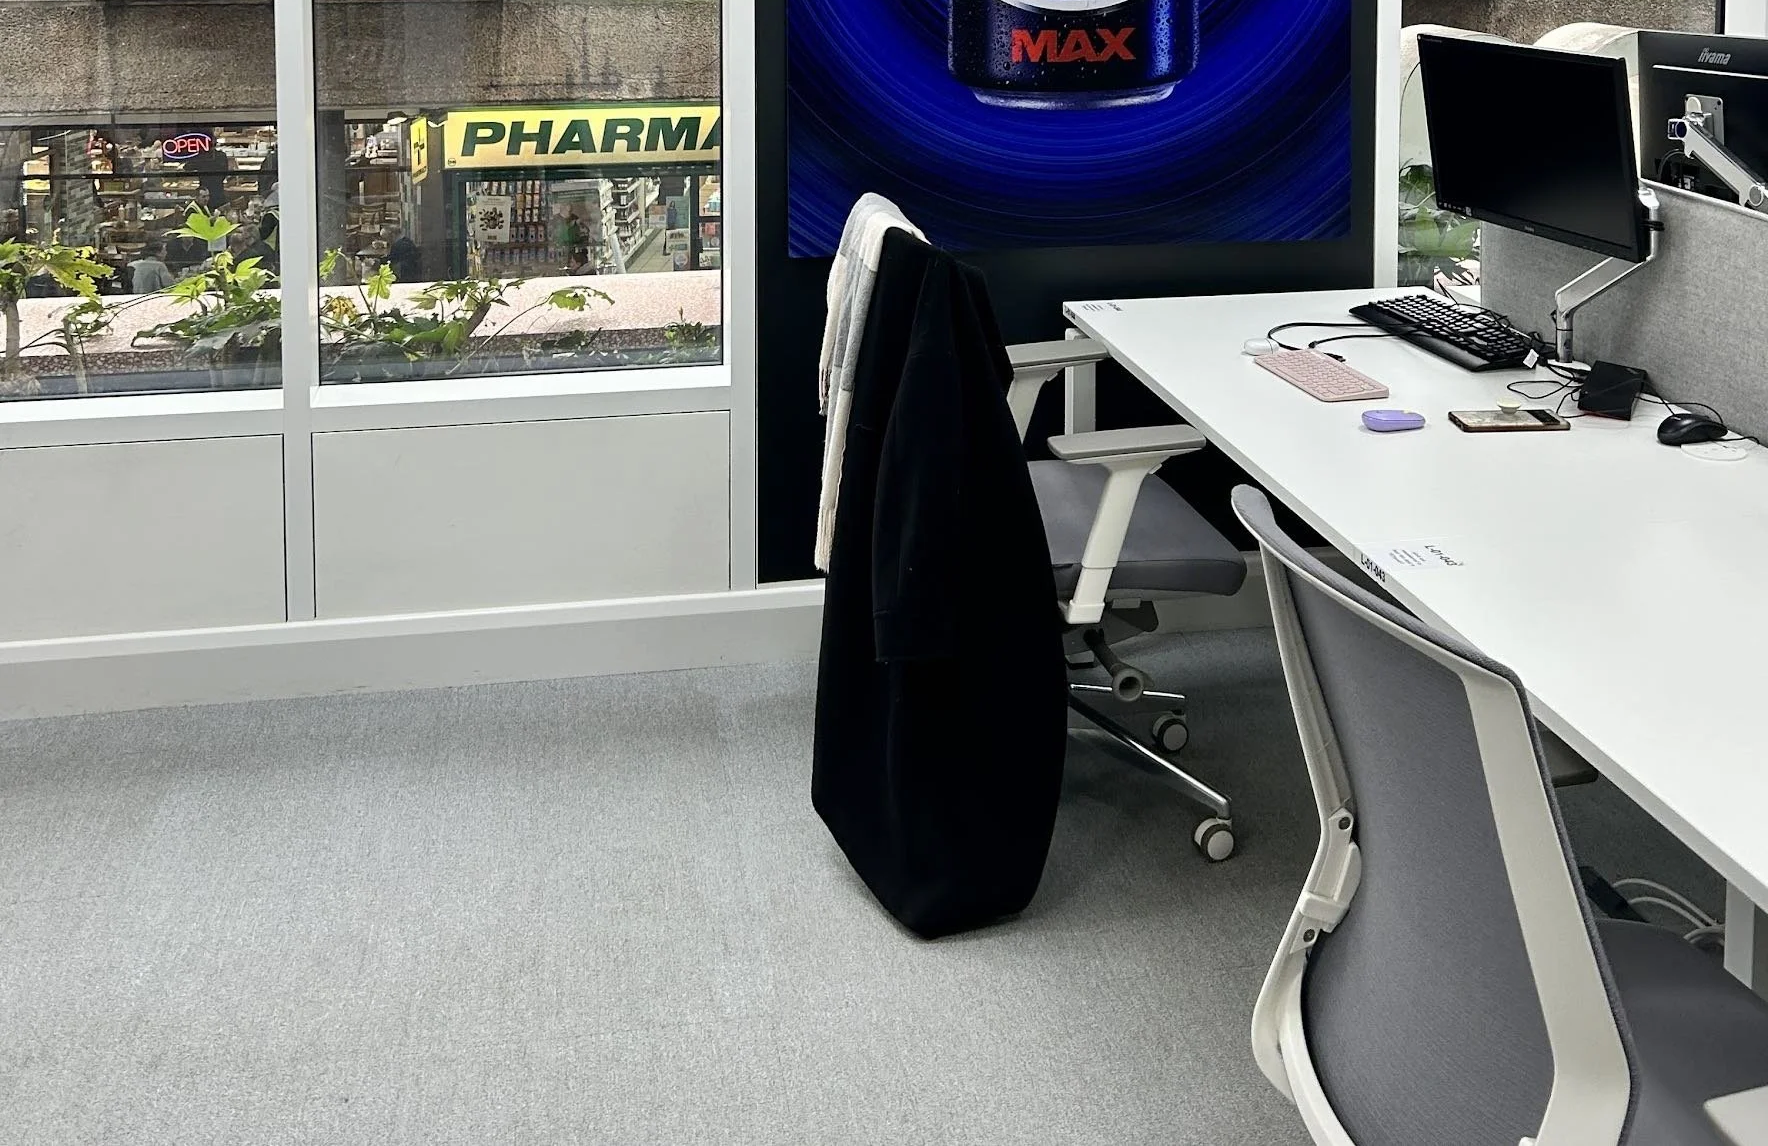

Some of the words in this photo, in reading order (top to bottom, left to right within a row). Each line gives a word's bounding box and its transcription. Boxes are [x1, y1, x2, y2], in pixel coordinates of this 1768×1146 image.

[1010, 27, 1137, 63] MAX
[1697, 46, 1731, 65] iiyama
[162, 137, 210, 154] OPEN
[1360, 553, 1386, 583] L-01-043
